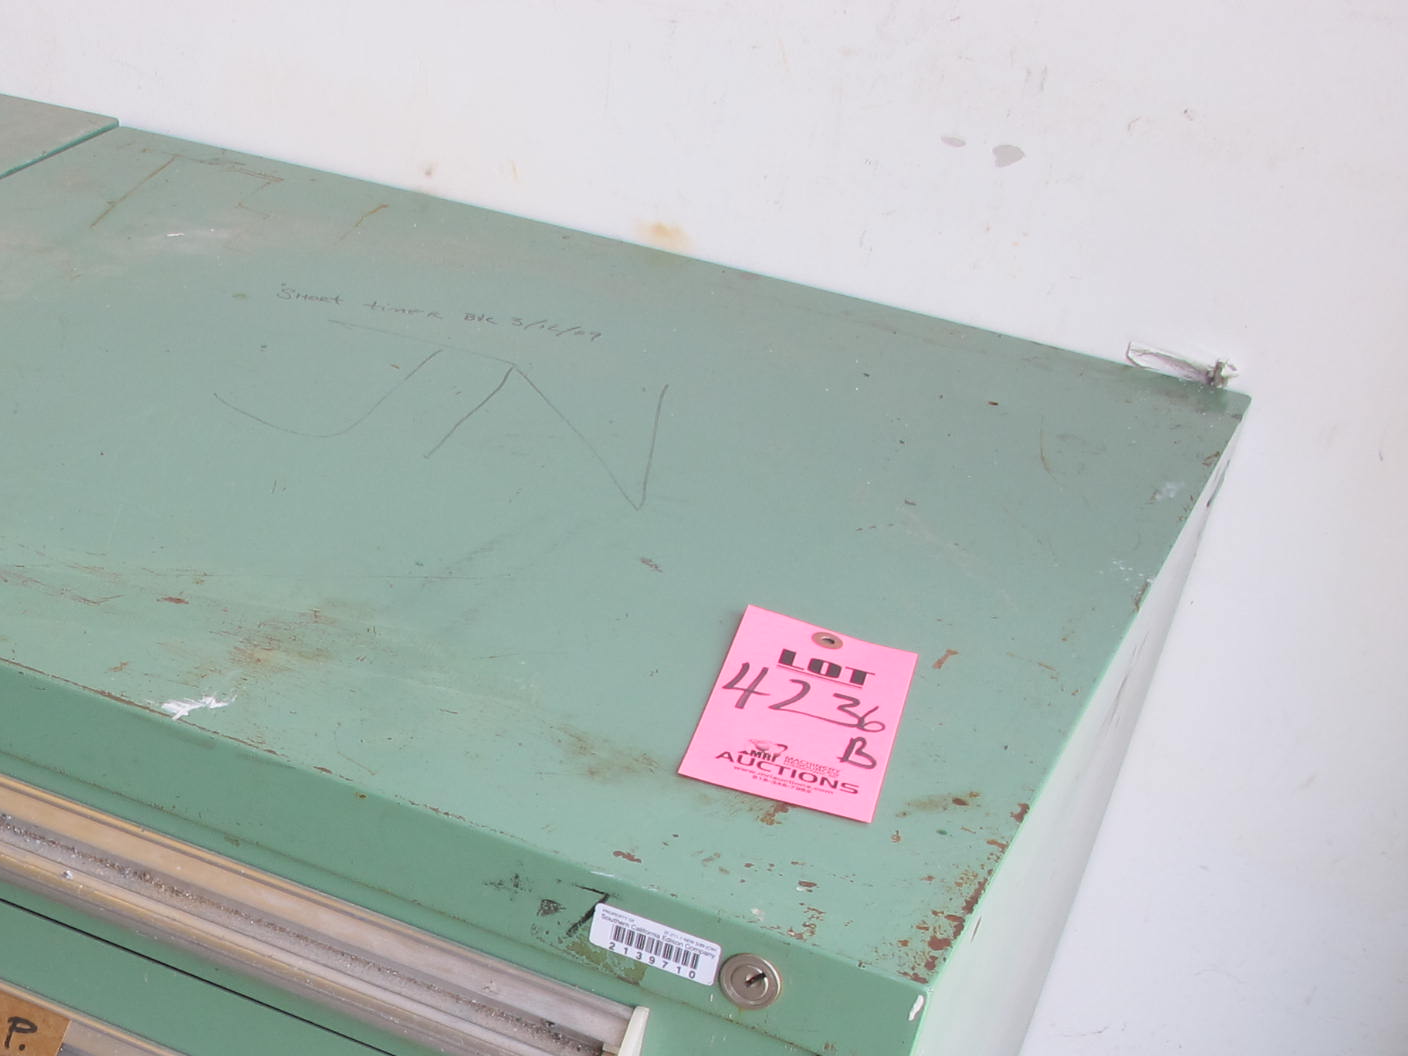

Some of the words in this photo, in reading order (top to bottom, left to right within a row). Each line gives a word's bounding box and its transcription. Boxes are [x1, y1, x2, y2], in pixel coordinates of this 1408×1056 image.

[777, 648, 876, 688] LOT
[715, 751, 860, 795] AUCTIONS
[2, 1016, 39, 1052] P.
